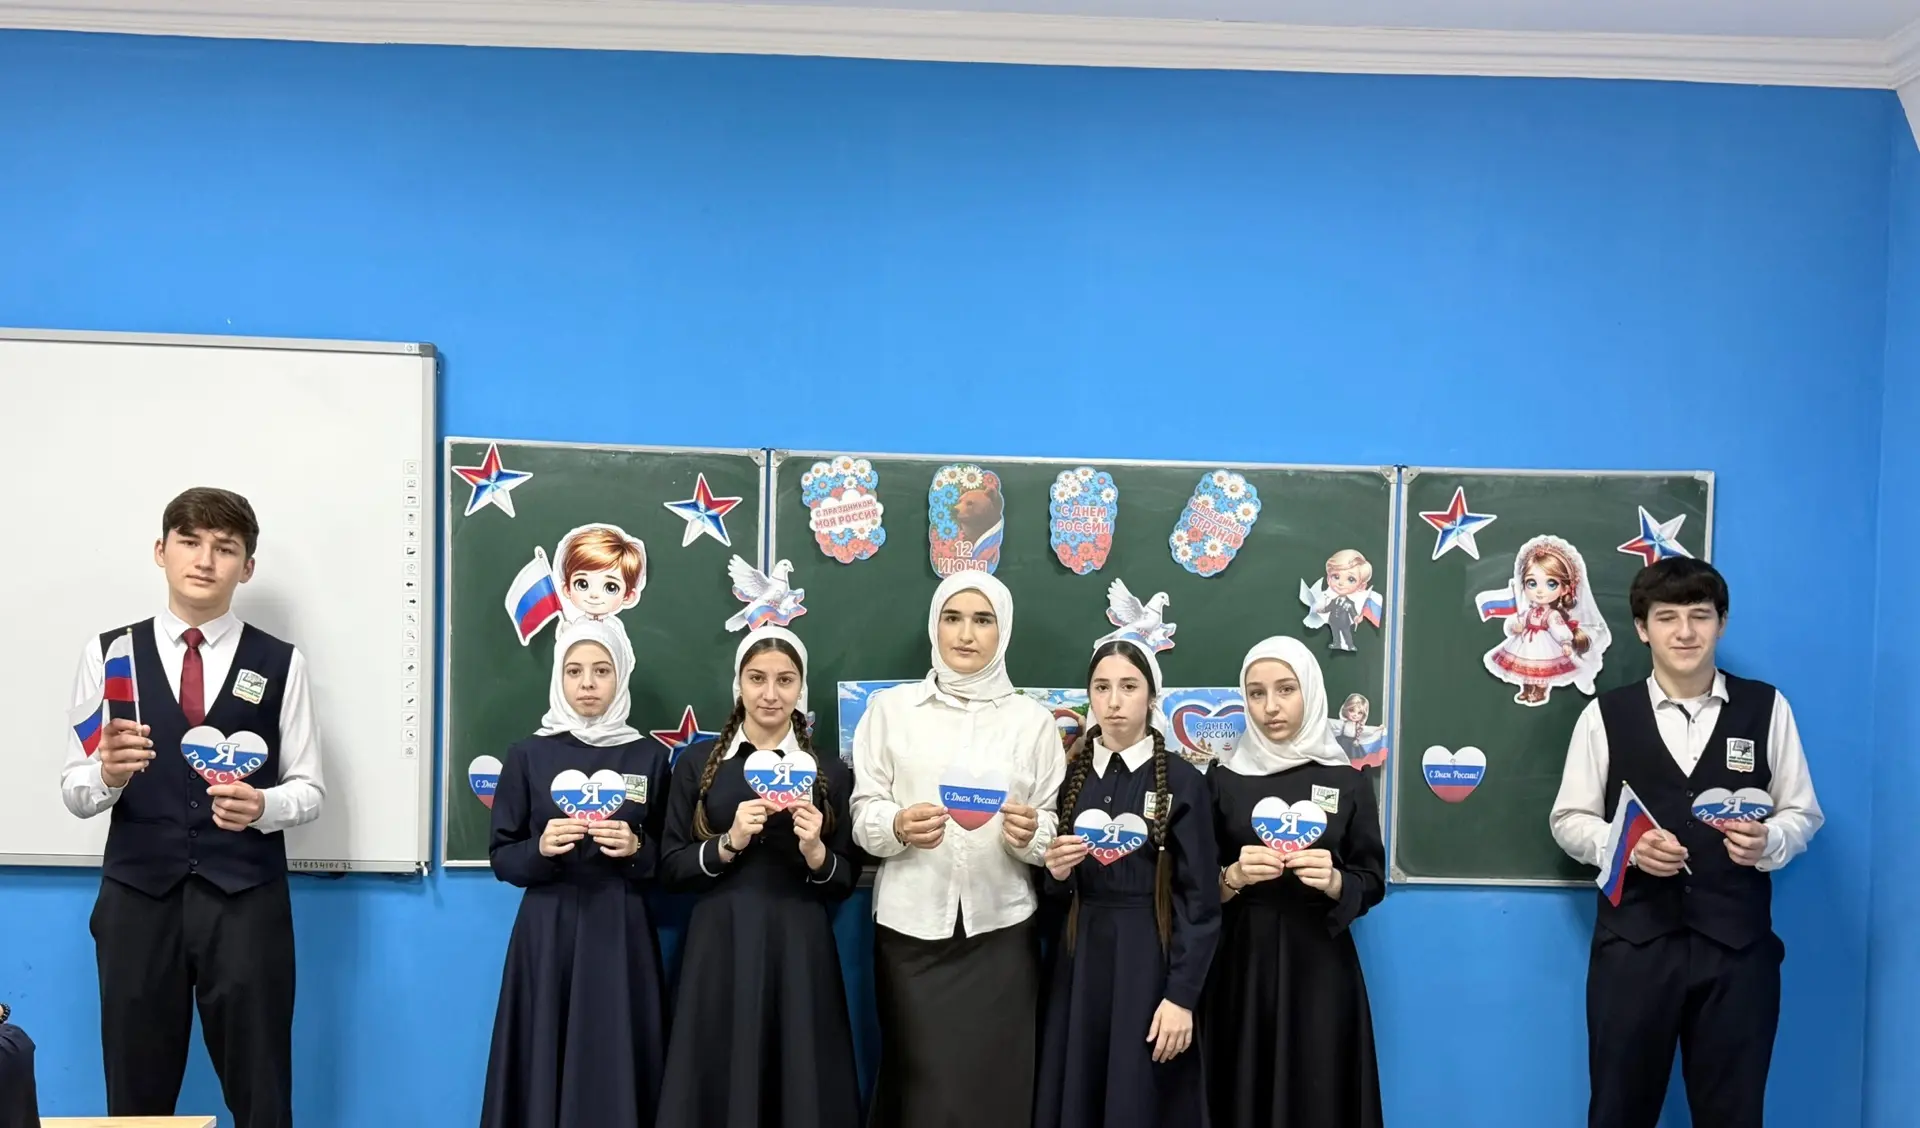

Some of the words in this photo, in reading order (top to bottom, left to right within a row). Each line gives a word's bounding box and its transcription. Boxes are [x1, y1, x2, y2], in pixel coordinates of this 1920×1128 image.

[815, 518, 836, 529] МОЯ
[838, 509, 878, 525] РОССИЯ
[1061, 505, 1069, 515] С
[1072, 506, 1107, 518] ДНЕМ
[1057, 521, 1110, 533] РОССИИ
[1189, 514, 1234, 546] СТРАНА
[954, 541, 973, 557] 12
[938, 558, 987, 573] ИЮНЯ
[1195, 722, 1203, 730] С
[1205, 722, 1233, 730] ДНЕМ
[208, 742, 240, 766] Я
[185, 750, 262, 783] РОССИЮ
[769, 763, 794, 786] Я
[577, 782, 602, 805] Я
[749, 775, 814, 804] РОССИЮ
[944, 792, 950, 800] С
[556, 794, 623, 822] РОССИЮ
[1716, 796, 1746, 815] Я
[1274, 811, 1302, 835] Я
[1696, 807, 1768, 827] РОСИЮ
[1097, 823, 1124, 844] Я
[1255, 822, 1322, 852] РОССИЮ
